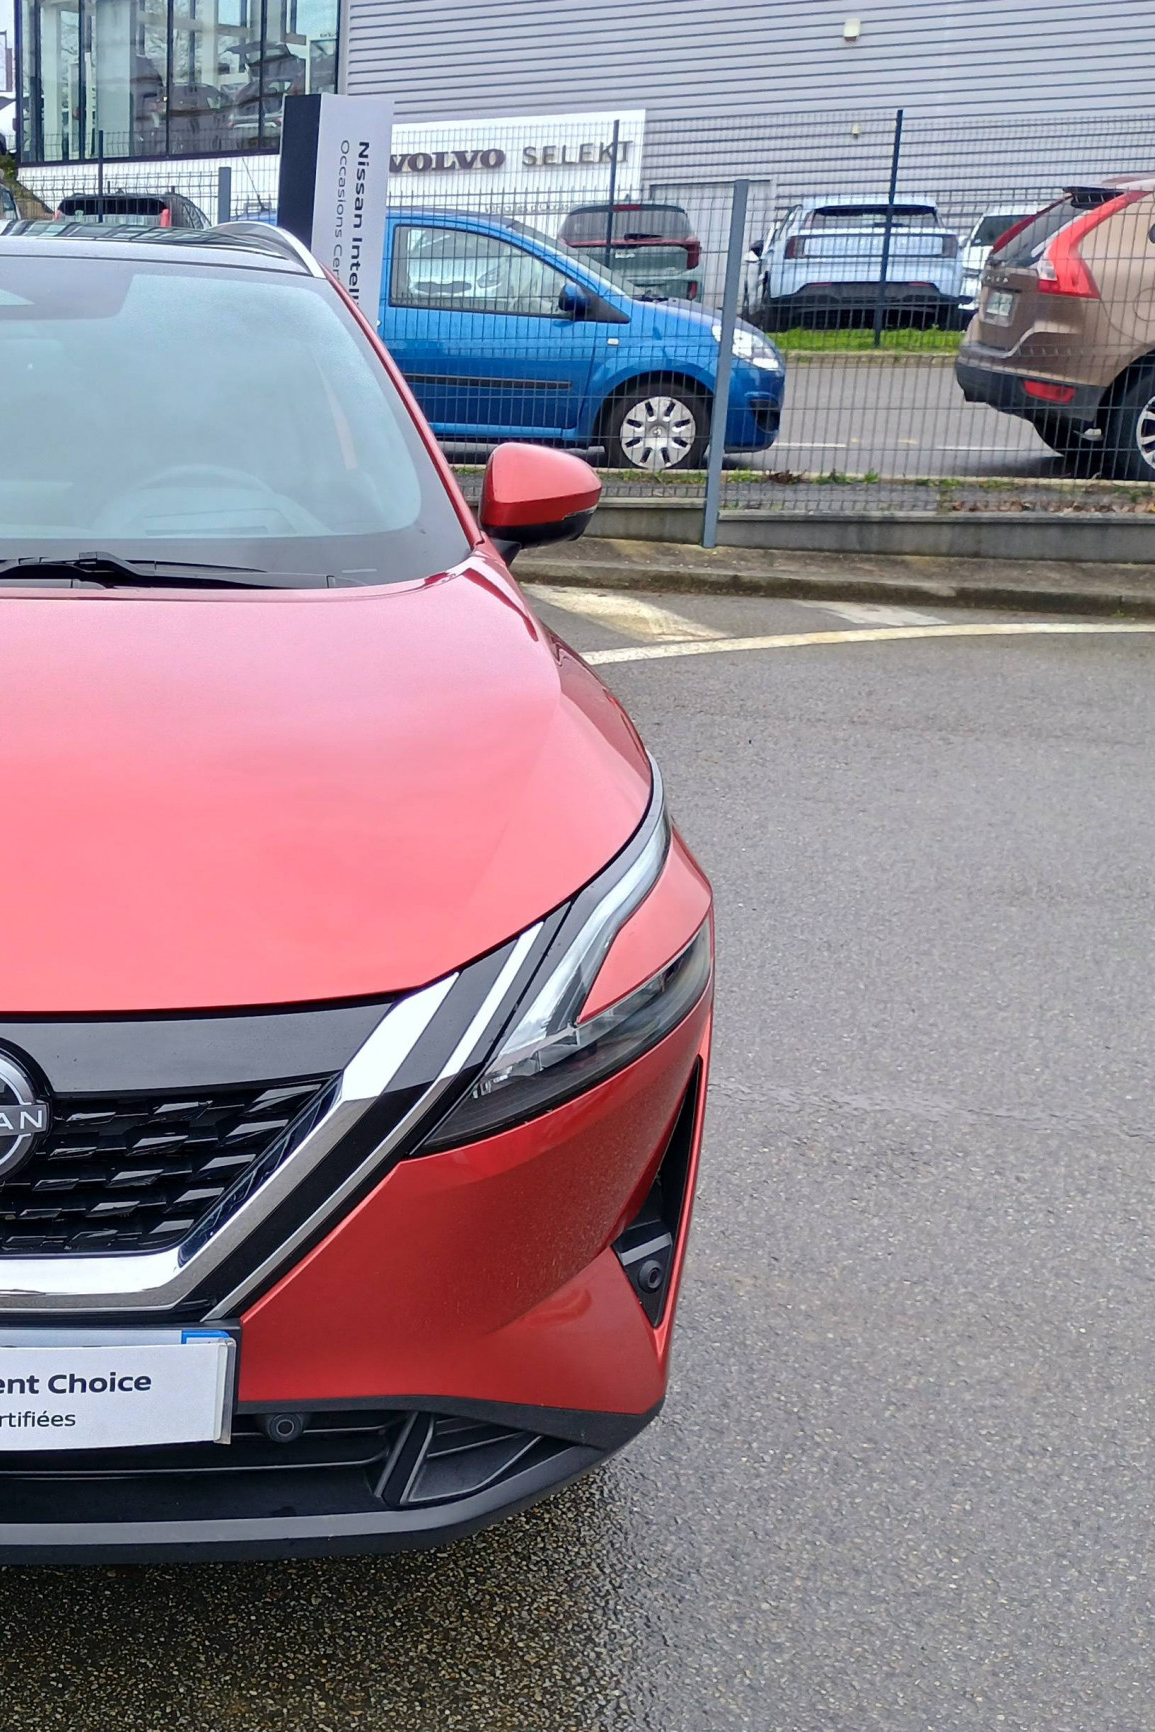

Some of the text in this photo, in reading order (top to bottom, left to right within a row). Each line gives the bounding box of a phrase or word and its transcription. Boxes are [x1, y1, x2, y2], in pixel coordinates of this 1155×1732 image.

[389, 140, 633, 173] VOLVO SELEKT
[332, 140, 350, 281] Occasions Cer
[348, 141, 370, 305] Nissan Intell
[47, 1372, 152, 1394] Choice
